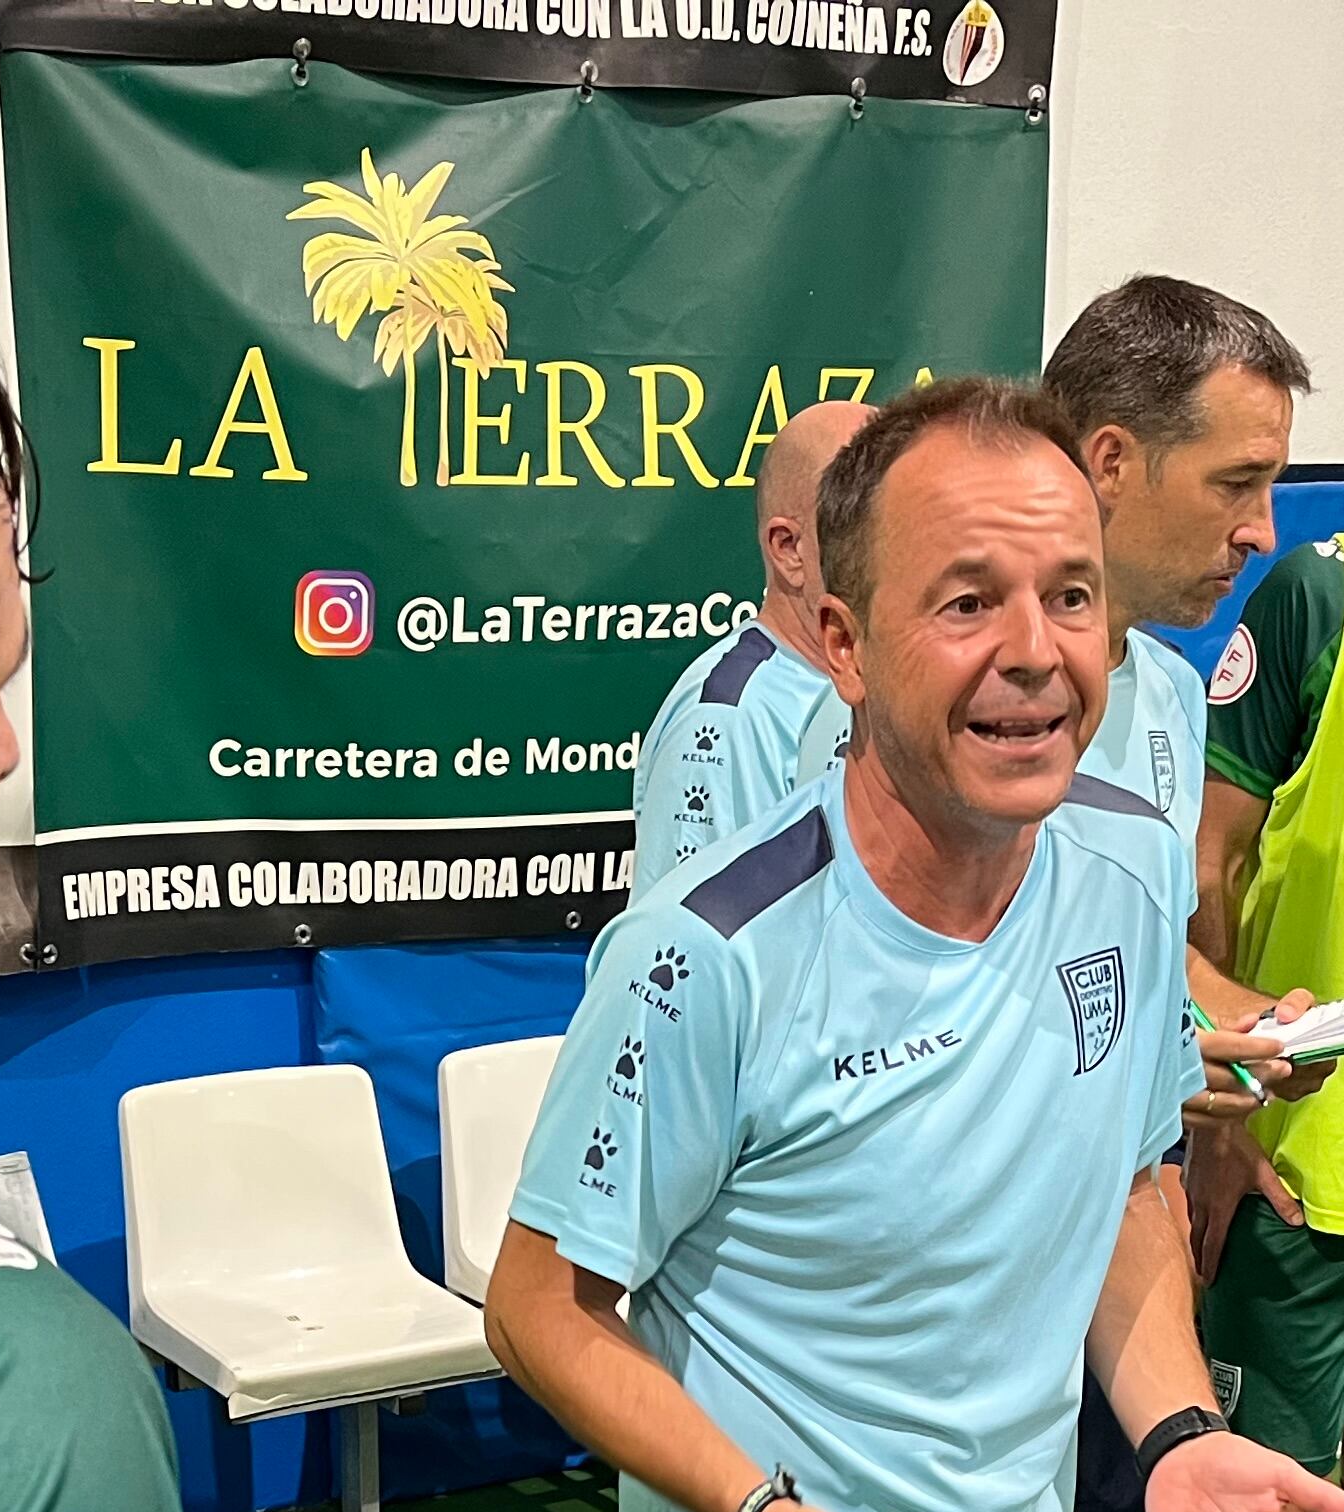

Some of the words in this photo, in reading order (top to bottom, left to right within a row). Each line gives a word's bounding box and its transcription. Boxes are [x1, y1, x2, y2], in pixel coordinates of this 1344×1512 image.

[894, 9, 932, 56] F.S.
[83, 337, 309, 484] LA
[208, 738, 438, 779] Carretera
[454, 737, 510, 777] de
[682, 753, 725, 767] KELME
[674, 813, 714, 826] KELME
[62, 863, 216, 921] EMPRESA
[227, 855, 519, 908] COLABORADORA
[526, 852, 596, 897] CON
[602, 849, 636, 892] LA
[1075, 963, 1113, 990] CLUB
[1082, 1002, 1113, 1022] UMA
[834, 1029, 962, 1081] KELME
